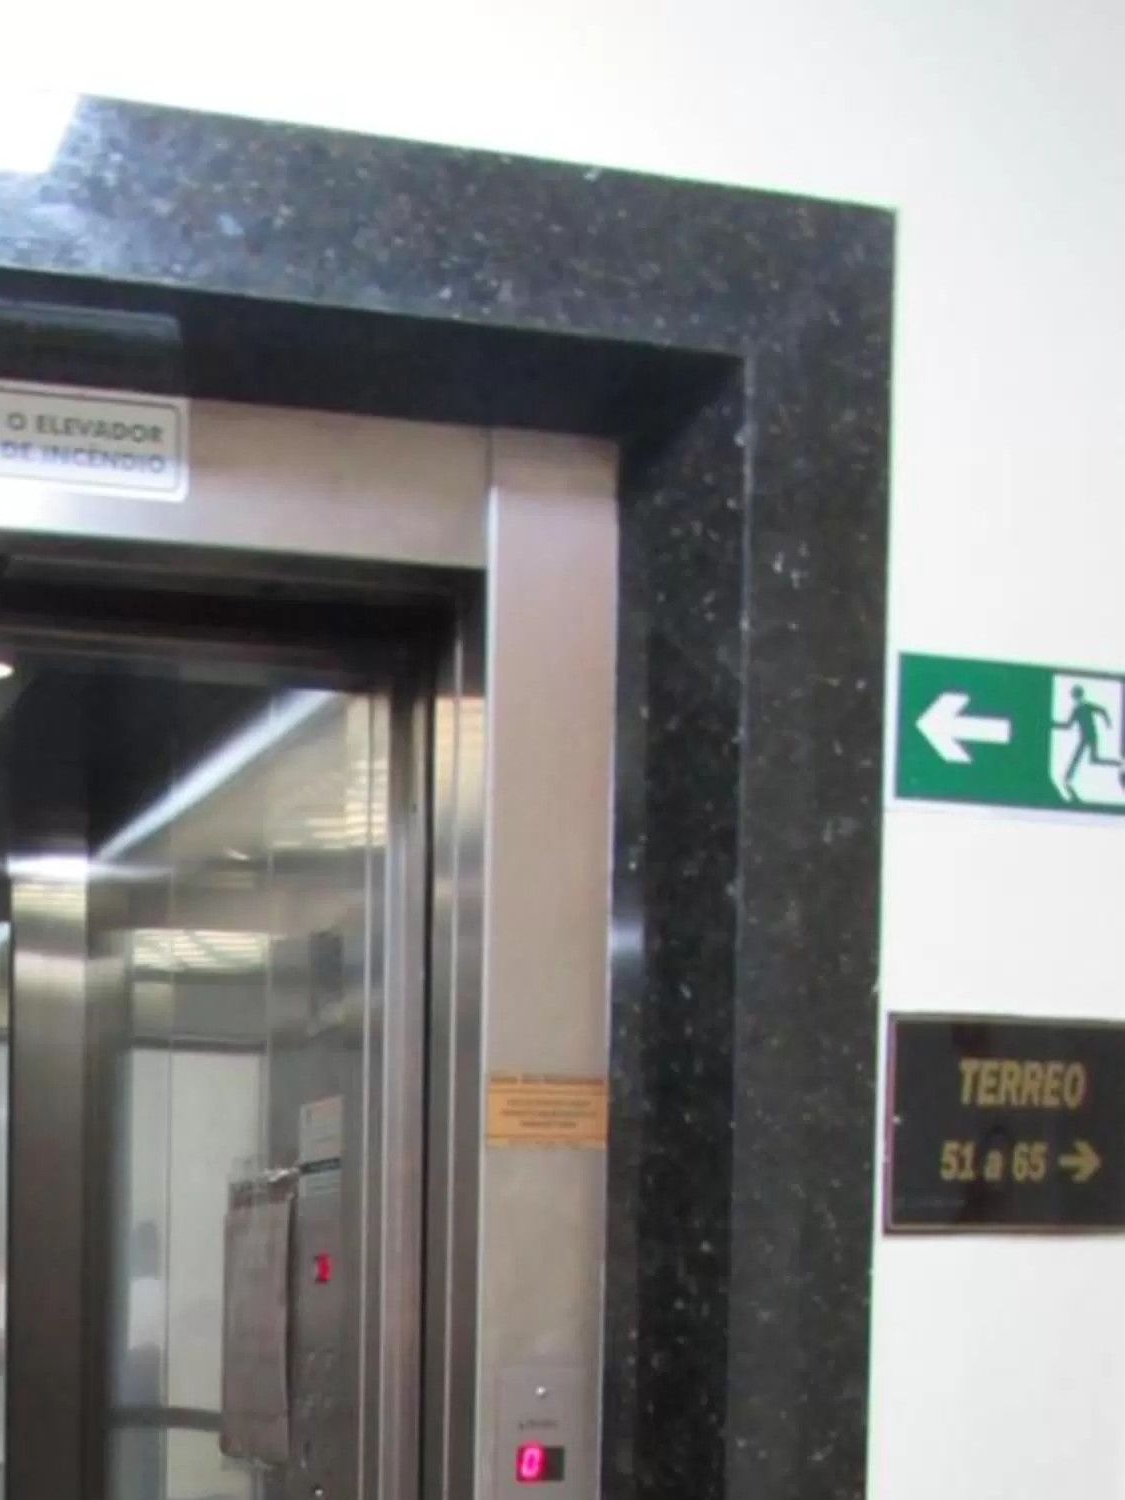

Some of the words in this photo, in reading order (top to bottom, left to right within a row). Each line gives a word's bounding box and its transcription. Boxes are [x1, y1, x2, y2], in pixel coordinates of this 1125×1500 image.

[6, 412, 27, 432] O
[36, 414, 163, 443] ELEVADOR
[0, 439, 33, 461] DE
[959, 1058, 1086, 1109] TERREO
[939, 1139, 976, 1180] 51
[1012, 1140, 1048, 1182] 65
[520, 1446, 544, 1480] 0
